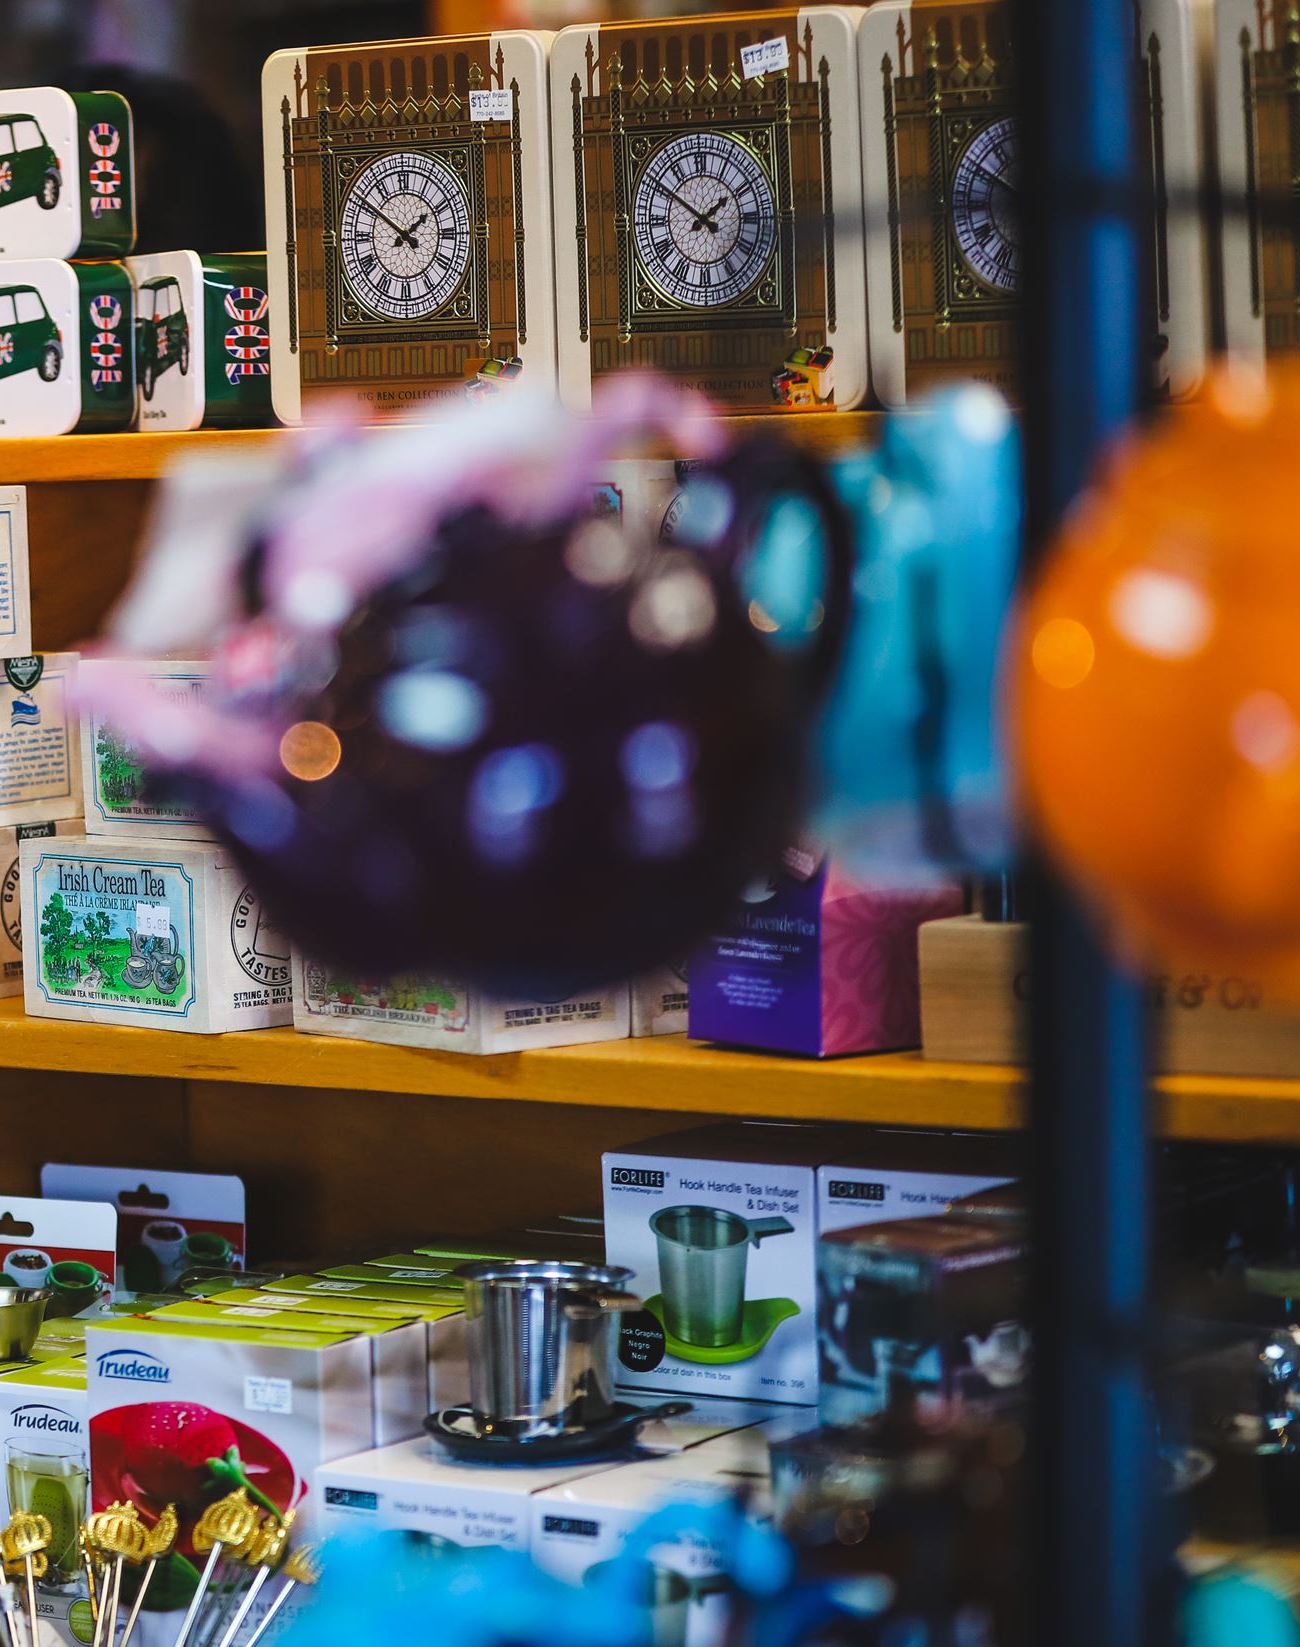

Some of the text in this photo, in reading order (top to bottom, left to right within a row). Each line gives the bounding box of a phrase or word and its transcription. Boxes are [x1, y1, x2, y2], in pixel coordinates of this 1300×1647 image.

[224, 286, 270, 385] 100
[377, 391, 396, 400] BEN
[398, 388, 460, 400] COLLECTION
[58, 864, 166, 897] Irish Cream Tea
[64, 892, 78, 907] THÉ
[85, 896, 94, 908] LA
[95, 894, 118, 910] CRÈME
[236, 893, 255, 928] GOO
[241, 947, 288, 980] TASTES
[55, 988, 77, 997] PREMIUM
[88, 991, 100, 999] NETT
[152, 998, 162, 1006] TEA
[162, 999, 176, 1008] BAGS
[234, 988, 287, 1002] STRING & TAG
[272, 996, 287, 1005] NETT
[334, 1004, 436, 1024] THÉ ENGLISH BREAKFAST
[504, 1001, 602, 1020] STRING & TAG TEA BAGS
[613, 1170, 662, 1186] FORLIFE
[680, 1178, 800, 1198] Hook Handle Tea Infuser
[830, 1183, 882, 1199] FORLIFE
[748, 1200, 800, 1213] & Dish Set
[635, 1329, 662, 1340] Graphite
[628, 1340, 650, 1350] Negro
[632, 1352, 648, 1360] Noir
[99, 1360, 170, 1380] Trudeau
[680, 1368, 695, 1377] dish
[705, 1370, 716, 1379] this
[718, 1372, 732, 1381] box
[13, 1414, 80, 1434] Trudeau
[394, 1502, 418, 1512] Hook
[425, 1504, 456, 1518] Handle
[462, 1508, 477, 1519] Tea
